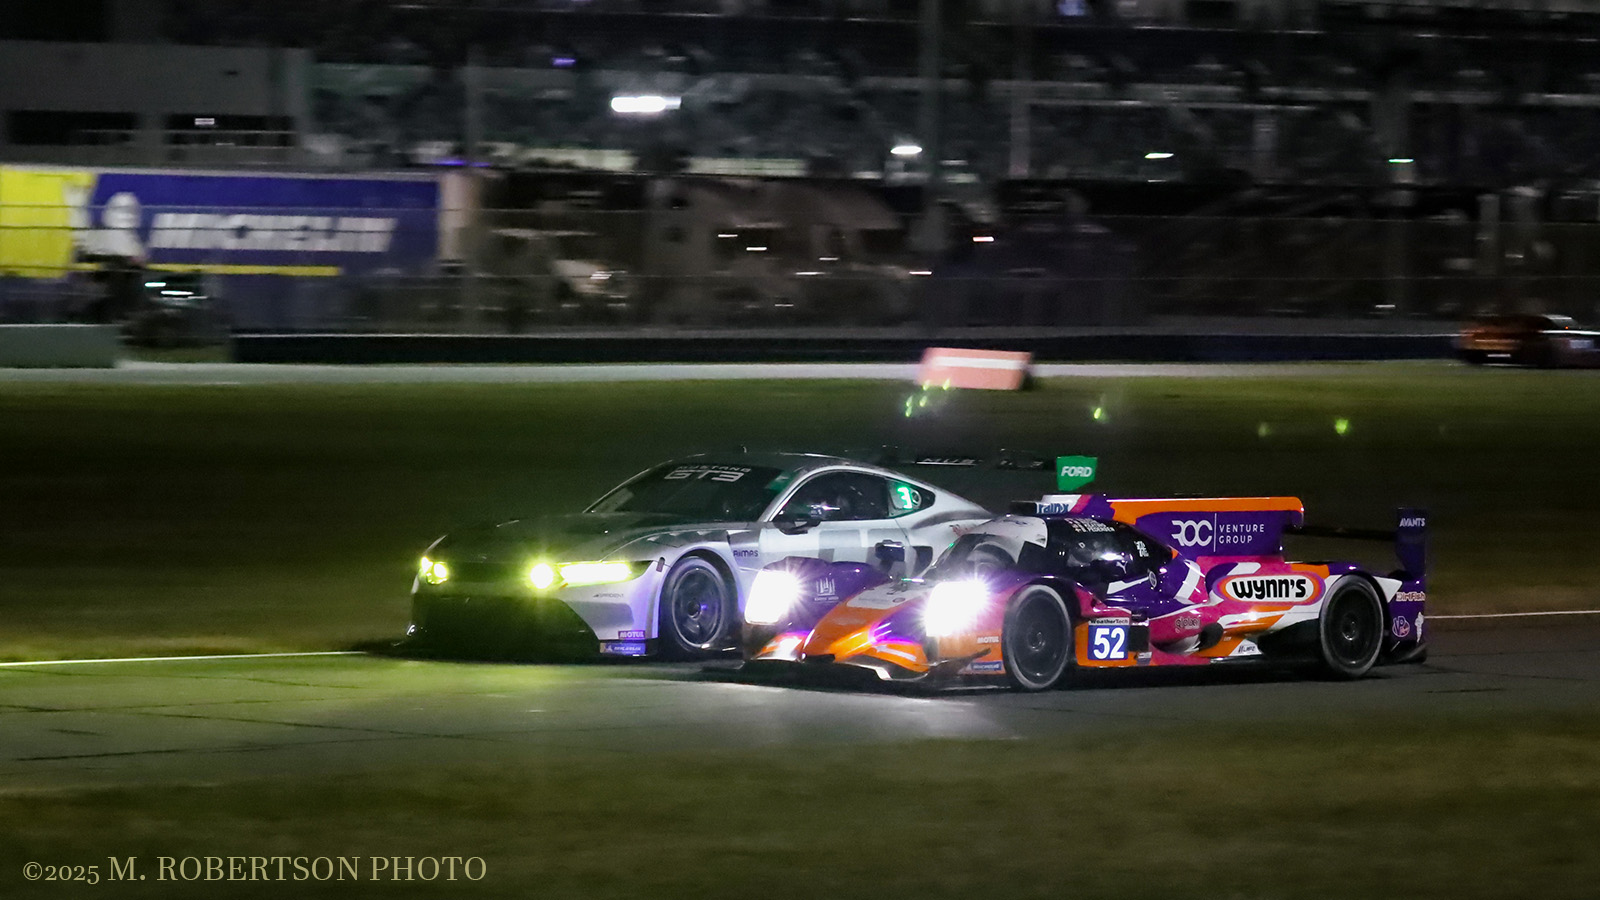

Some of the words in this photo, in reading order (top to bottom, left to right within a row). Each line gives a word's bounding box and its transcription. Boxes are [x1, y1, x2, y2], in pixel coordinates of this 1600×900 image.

[664, 469, 745, 482] GT3
[1060, 465, 1093, 477] FORD
[1399, 518, 1426, 527] AVANTS
[1171, 520, 1213, 547] ROC
[1219, 524, 1265, 533] VENTURE
[1218, 535, 1253, 544] GROUP
[1090, 617, 1129, 625] WeatherTech
[977, 635, 1000, 643] MOTUL
[1093, 627, 1126, 659] 52
